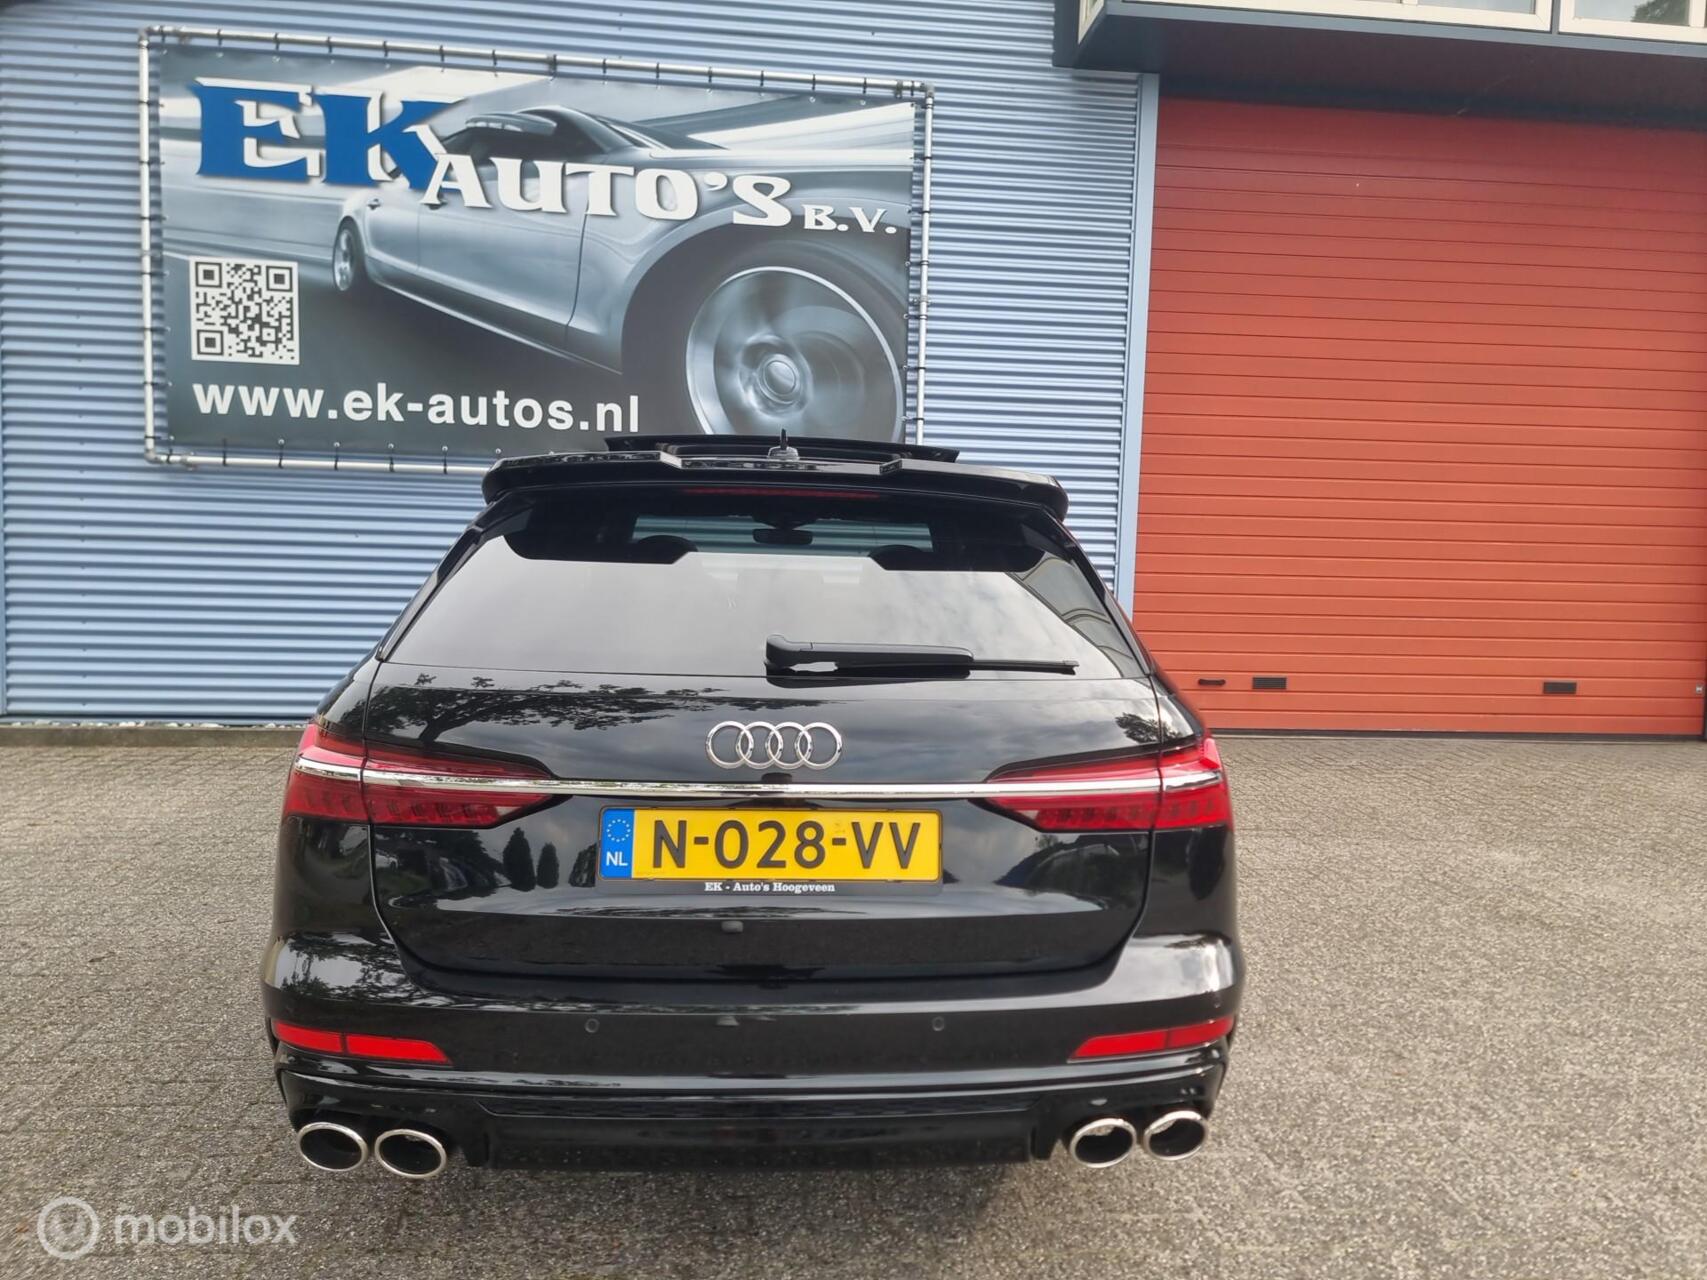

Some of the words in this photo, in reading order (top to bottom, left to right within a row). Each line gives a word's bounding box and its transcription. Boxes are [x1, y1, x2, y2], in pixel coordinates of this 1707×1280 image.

[194, 77, 464, 192] EK
[802, 203, 898, 235] B.V.
[191, 380, 640, 434] www.ek-autos.nl
[606, 851, 628, 867] NL
[652, 819, 921, 870] N-028-VV
[704, 882, 723, 892] EK
[733, 881, 770, 893] Auto's
[773, 882, 836, 895] Hoogeveen
